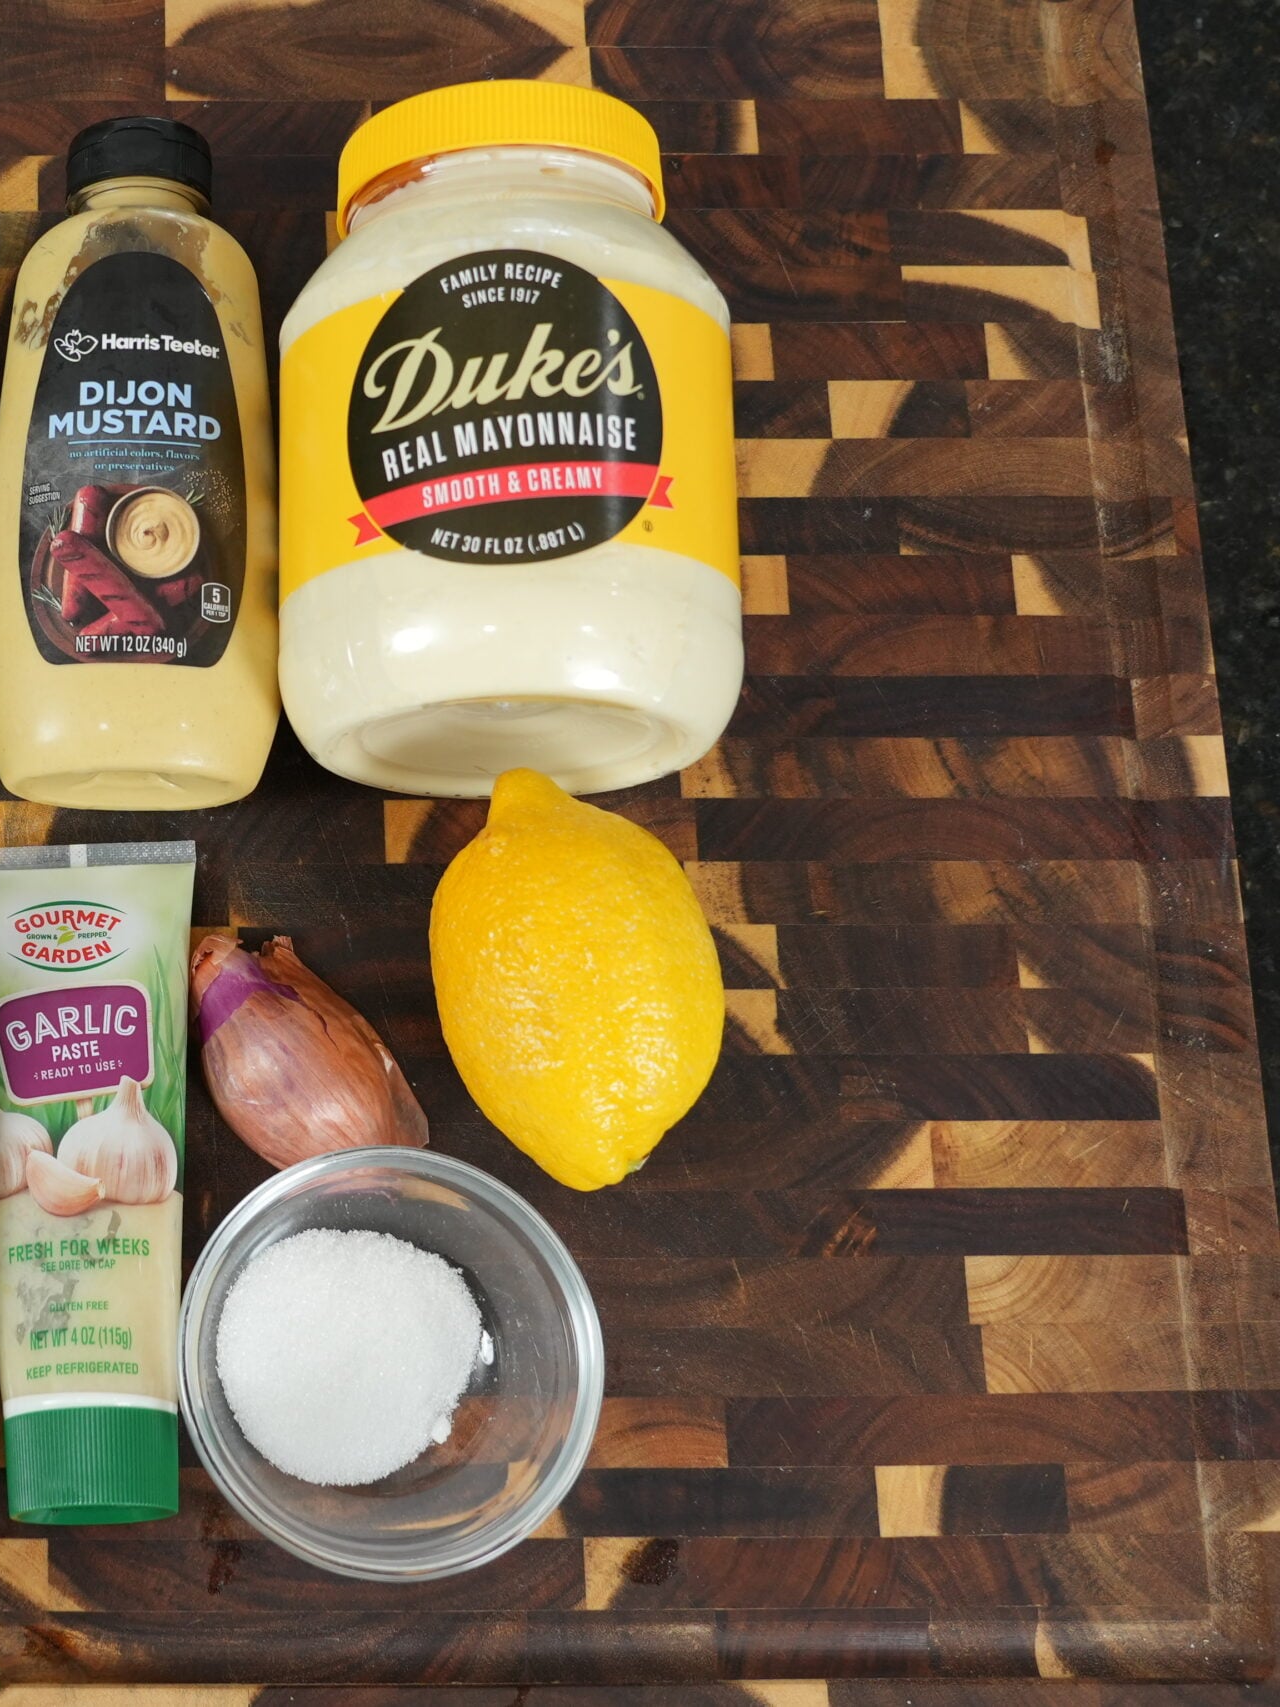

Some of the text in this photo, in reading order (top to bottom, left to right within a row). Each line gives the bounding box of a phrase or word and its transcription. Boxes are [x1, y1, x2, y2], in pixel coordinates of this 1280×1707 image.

[440, 263, 563, 294] FAMILY RECIPE
[462, 287, 540, 308] SINCE 1917
[101, 333, 220, 359] Harris Teeter
[363, 322, 643, 435] Duke's
[79, 380, 192, 409] DIJON
[48, 409, 221, 440] MUSTARD
[84, 448, 128, 457] artificial
[130, 449, 163, 459] colors,
[166, 450, 200, 461] flavors
[381, 411, 637, 482] REAL MAYONNAISE
[108, 462, 175, 472] preservatives
[28, 492, 61, 505] SUGGESTION
[29, 484, 50, 495] SERVING
[422, 466, 603, 508] SMOOTH & CREAMY
[431, 527, 460, 549] NET
[462, 536, 481, 553] 30
[484, 537, 501, 554] FL
[504, 537, 523, 554] OZ
[213, 588, 220, 603] 5
[76, 636, 96, 652] NET
[100, 636, 119, 652] WT
[122, 636, 133, 652] 12
[135, 636, 150, 654] OZ
[15, 909, 121, 933] GOURMET
[21, 940, 112, 964] GARDEN
[6, 1004, 138, 1052] GARLIC
[51, 1040, 99, 1062] PASTE
[41, 1060, 116, 1080] READY TO USE
[8, 1238, 150, 1264] FRESH FOR WEEKS
[41, 1259, 116, 1272] SEE DATE ON CAP
[49, 1301, 109, 1312] GLUTEN FREE
[30, 1327, 132, 1350] NET WT 4 OZ (115g)
[26, 1361, 139, 1380] KEEP REFRIGERATED
